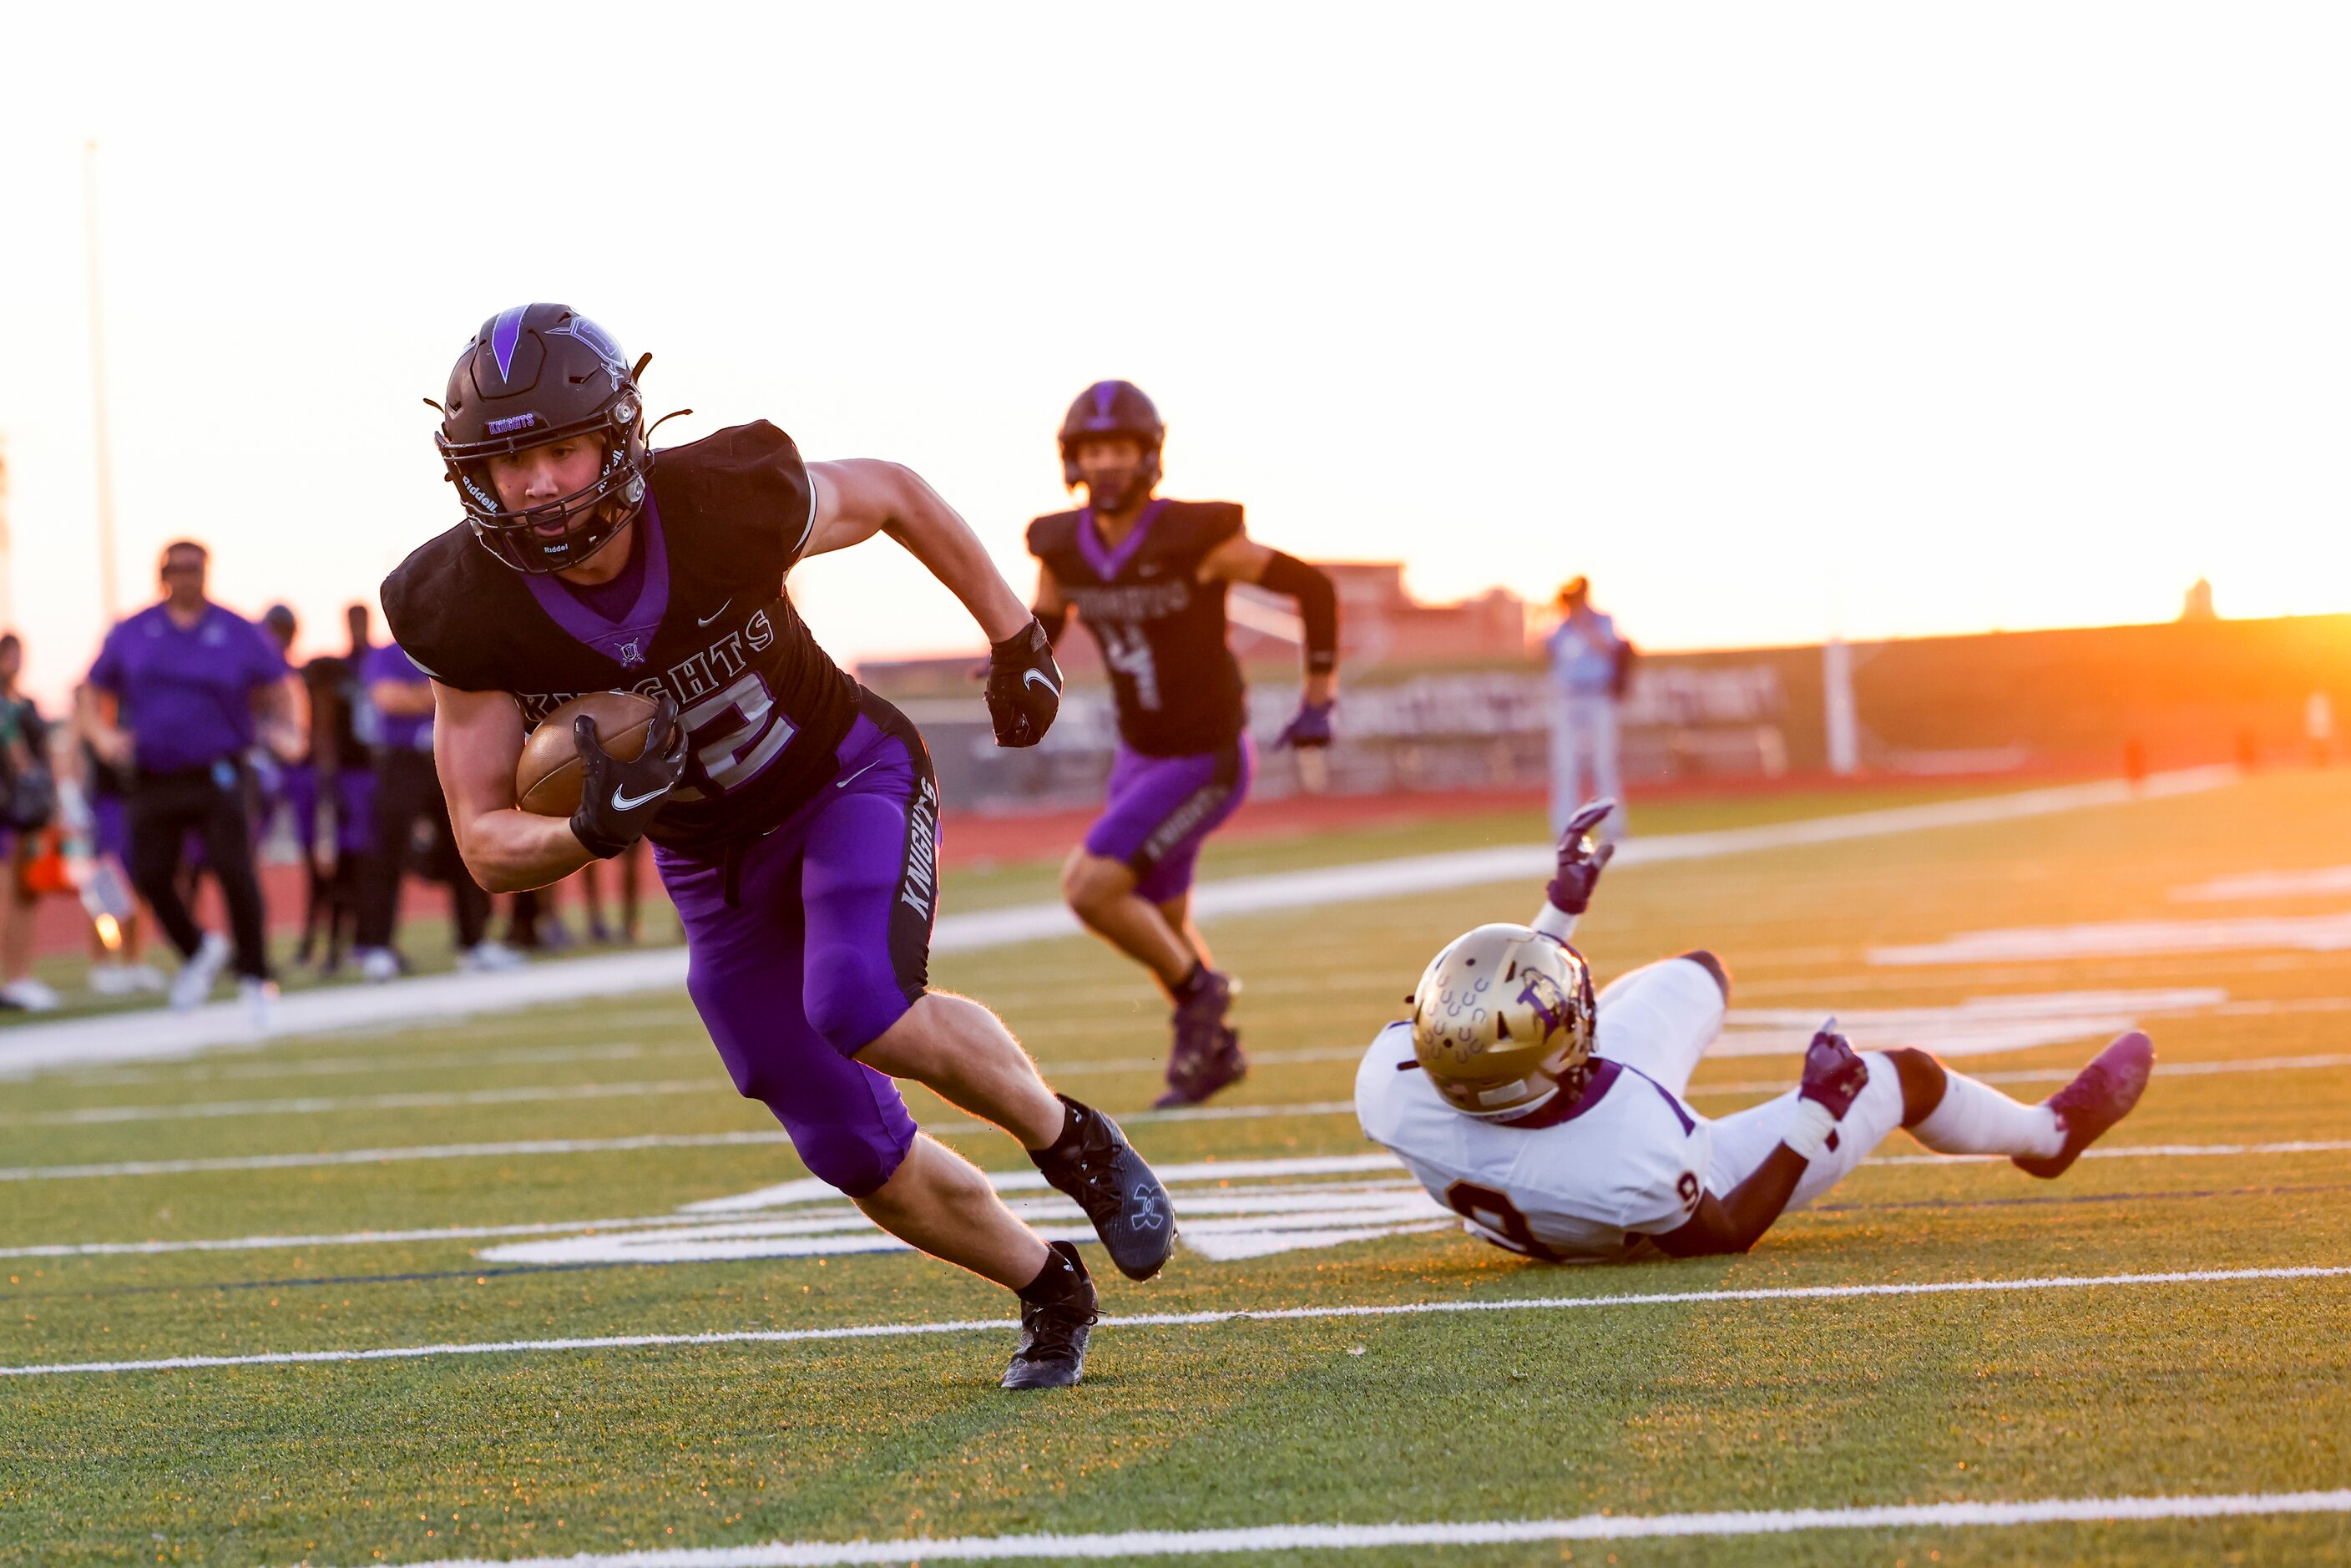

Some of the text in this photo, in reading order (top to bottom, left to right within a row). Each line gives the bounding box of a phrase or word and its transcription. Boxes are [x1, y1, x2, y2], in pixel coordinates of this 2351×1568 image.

[488, 413, 534, 435] KNIGHTS
[544, 543, 569, 554] Riddel
[514, 609, 775, 723] KGHTS
[1099, 620, 1162, 711] 4
[666, 670, 801, 803] 2
[901, 776, 938, 921] KNIGHTS
[1676, 1171, 1700, 1212] 9
